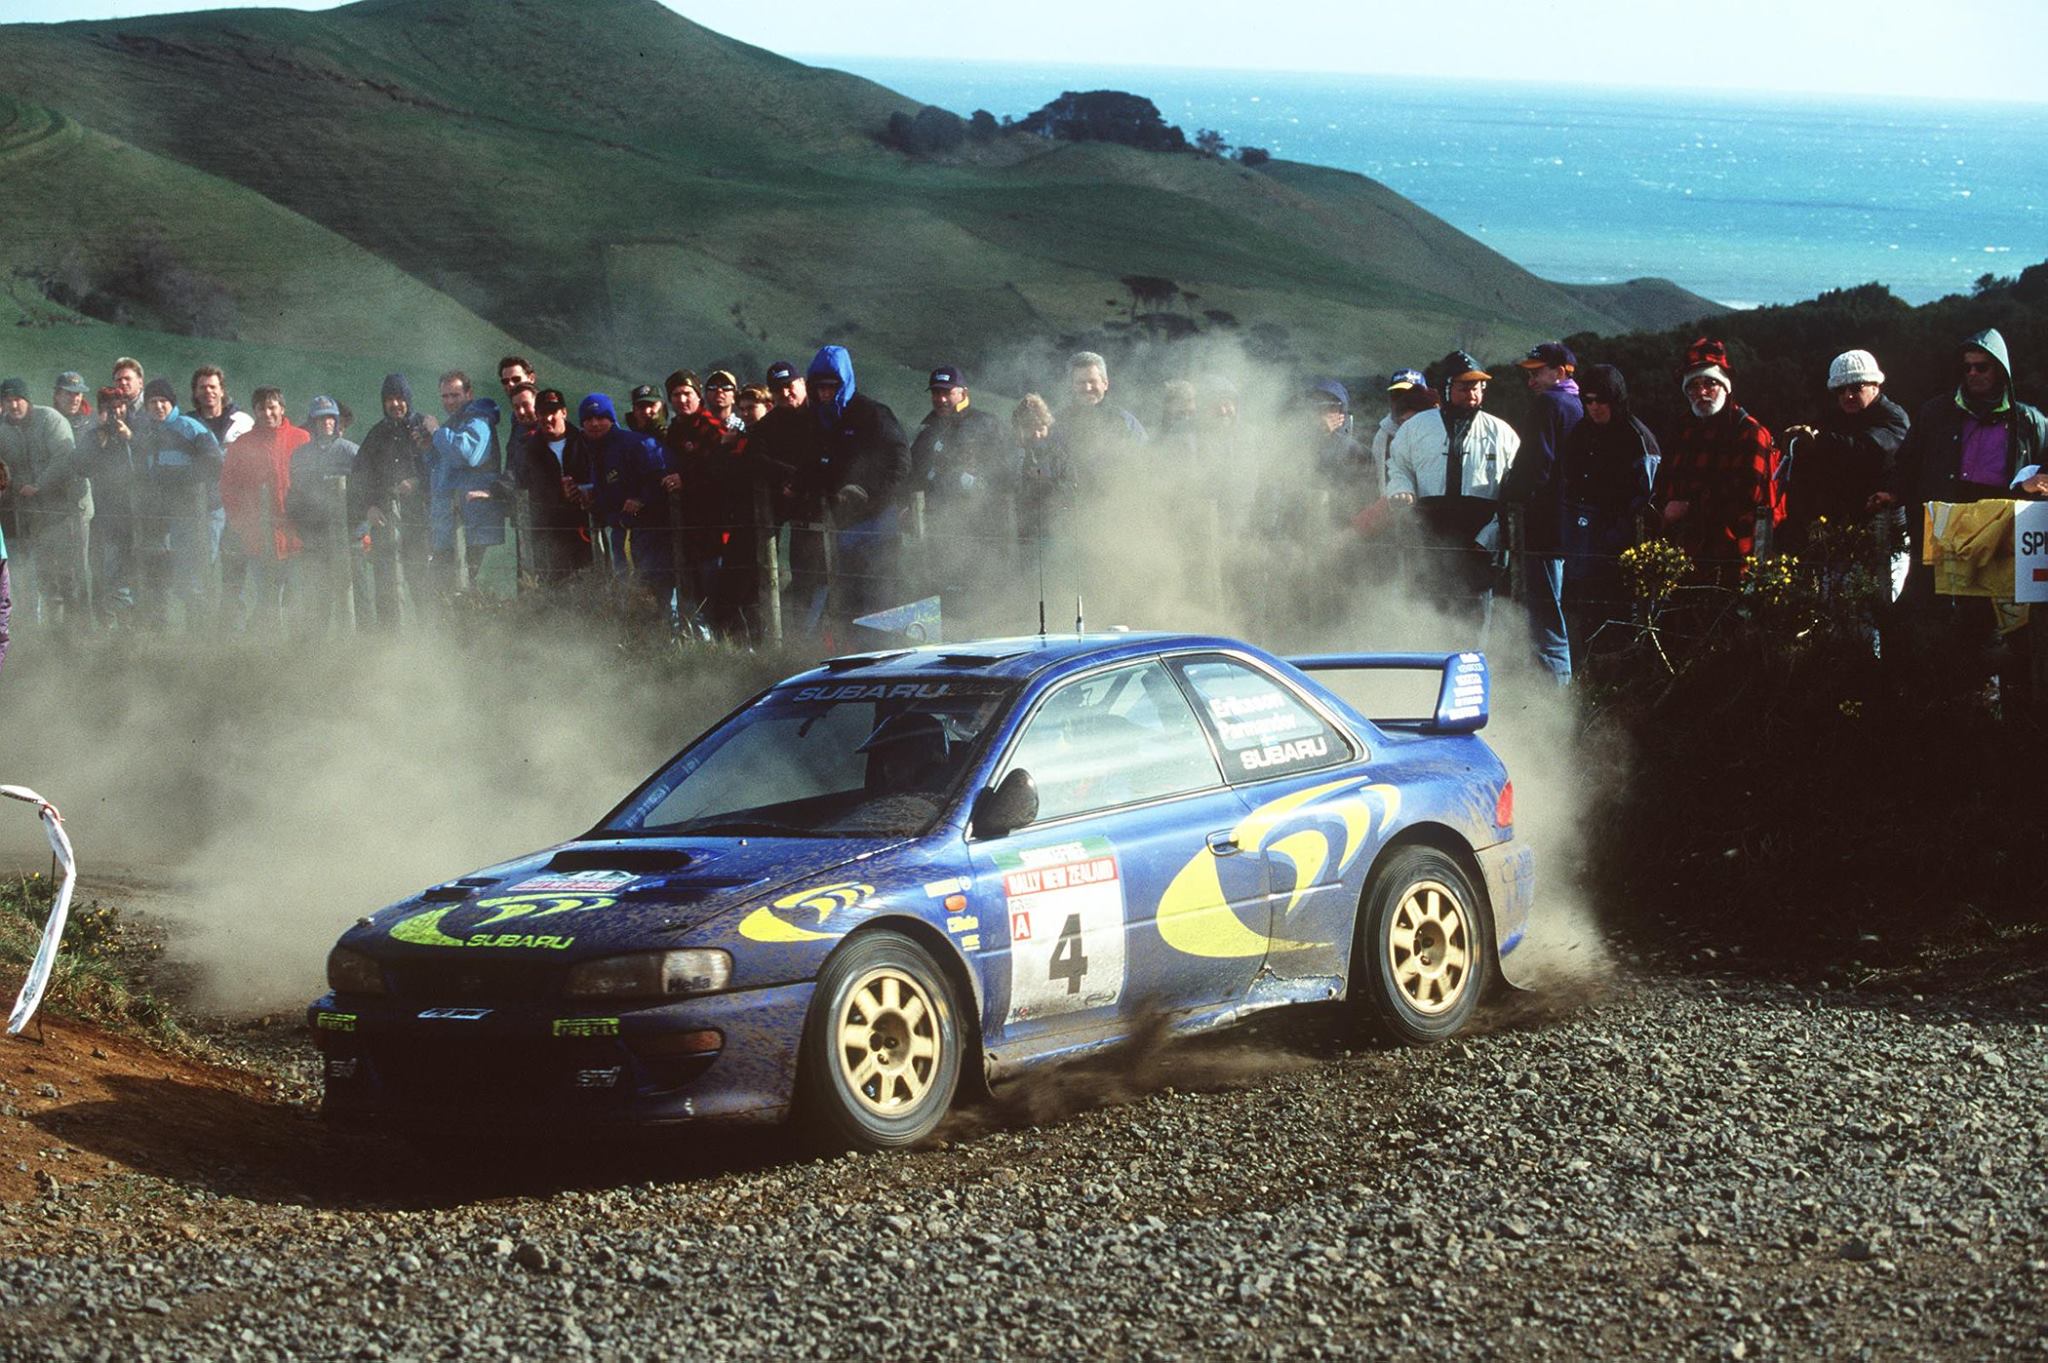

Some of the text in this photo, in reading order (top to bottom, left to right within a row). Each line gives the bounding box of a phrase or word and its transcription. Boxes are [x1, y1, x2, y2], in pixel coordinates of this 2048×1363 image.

[793, 684, 950, 701] SUBARU
[1240, 736, 1328, 770] SUBARU
[1008, 858, 1115, 895] RALLY NEW ZEALAND
[1014, 913, 1031, 940] A
[466, 934, 576, 950] SUBARU
[1049, 913, 1088, 996] 4
